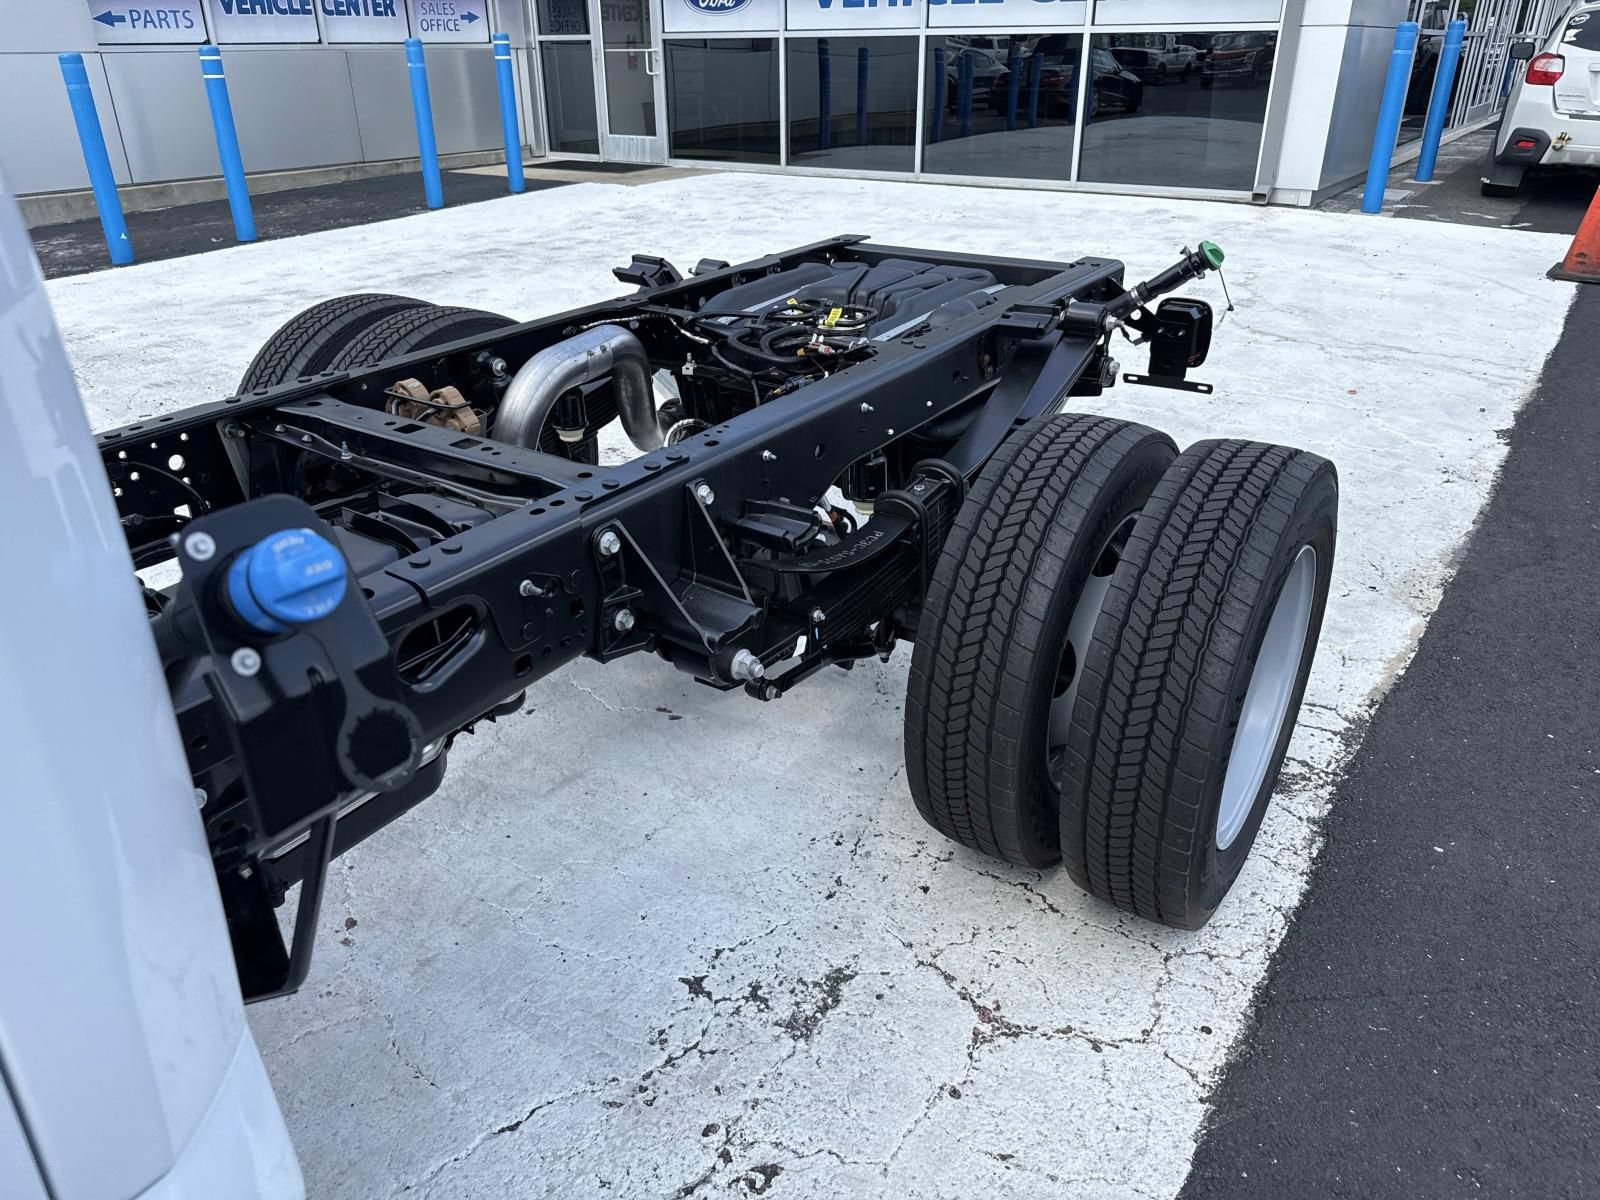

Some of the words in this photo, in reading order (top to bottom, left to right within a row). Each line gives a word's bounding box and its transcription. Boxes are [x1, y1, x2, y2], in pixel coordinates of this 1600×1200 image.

[420, 2, 456, 16] SALES
[128, 9, 195, 30] PARTS
[420, 18, 461, 32] OFFICE
